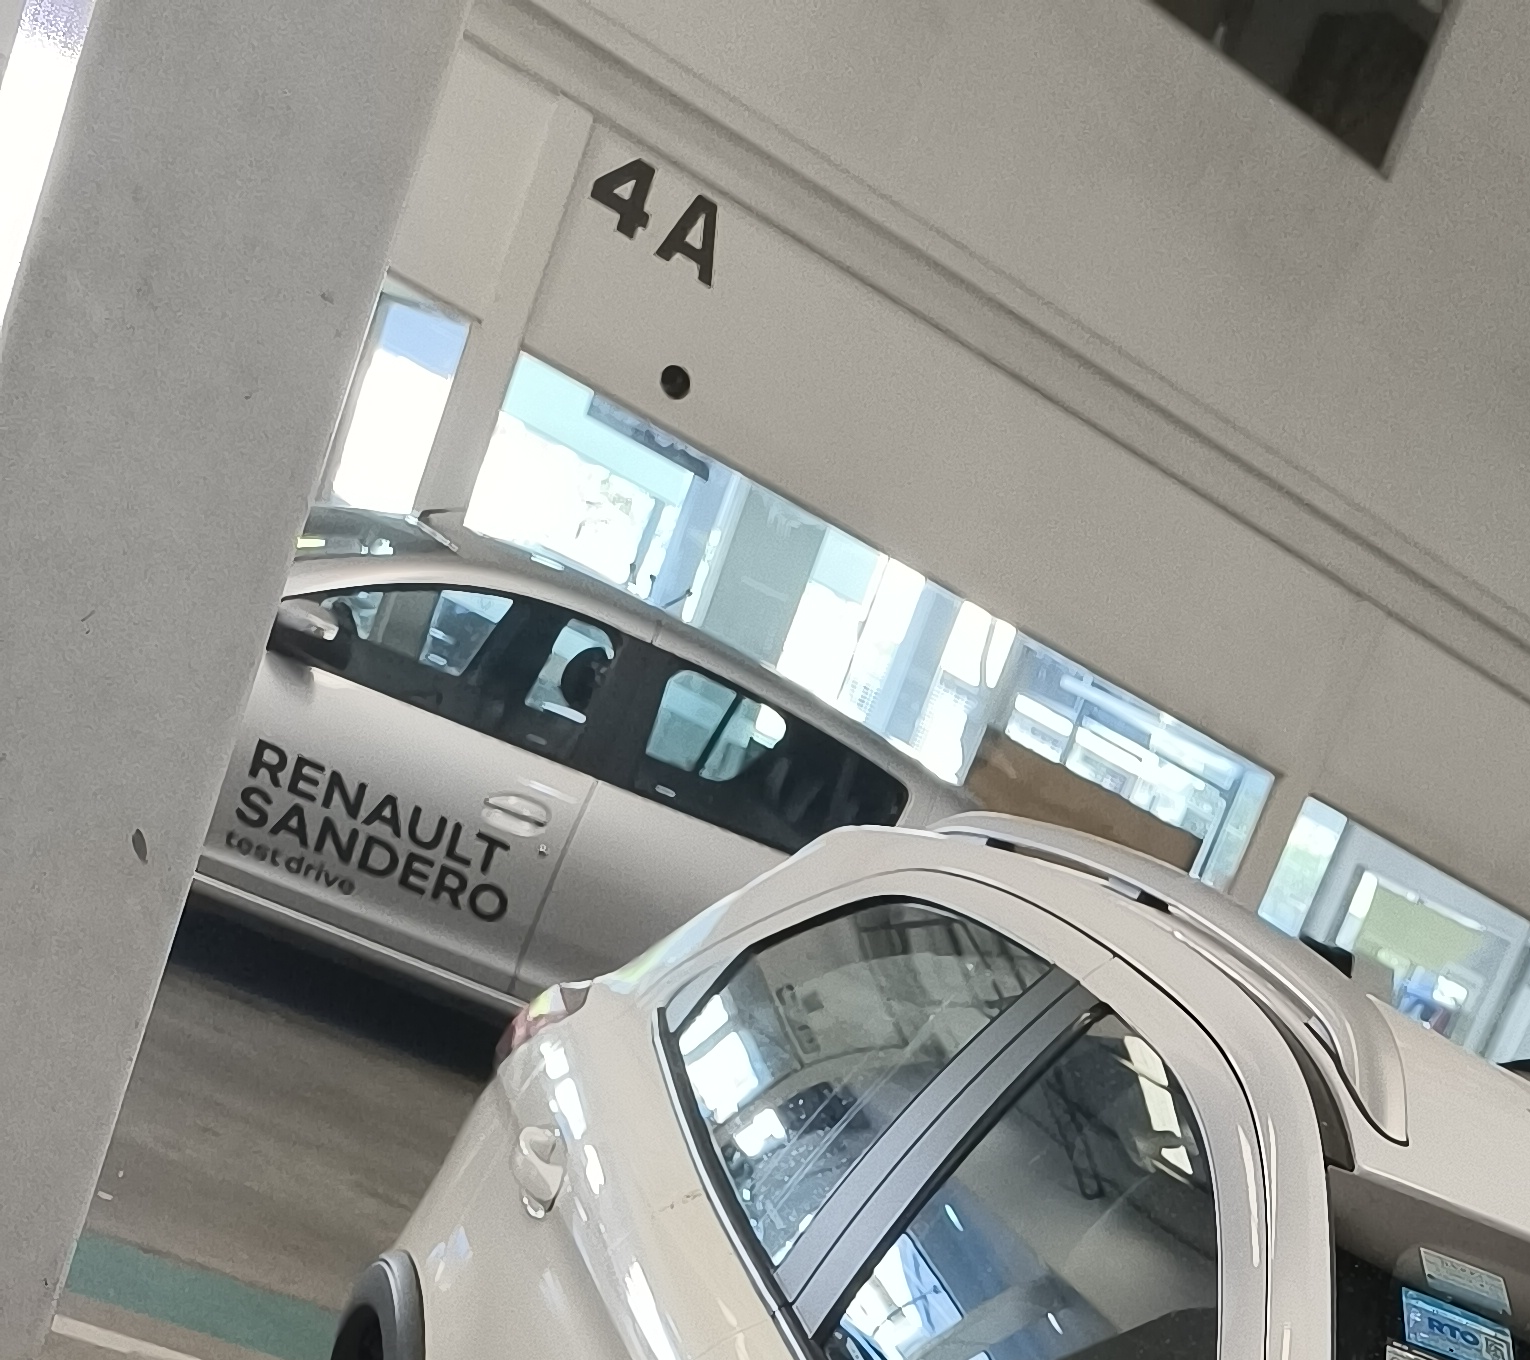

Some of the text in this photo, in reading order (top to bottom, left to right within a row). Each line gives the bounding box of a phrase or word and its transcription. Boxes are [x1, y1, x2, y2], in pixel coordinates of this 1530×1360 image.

[590, 157, 718, 288] 4A
[235, 786, 509, 922] SANDERO
[247, 738, 511, 875] RENAULT
[284, 855, 355, 896] drive
[1427, 1316, 1480, 1346] RTO
